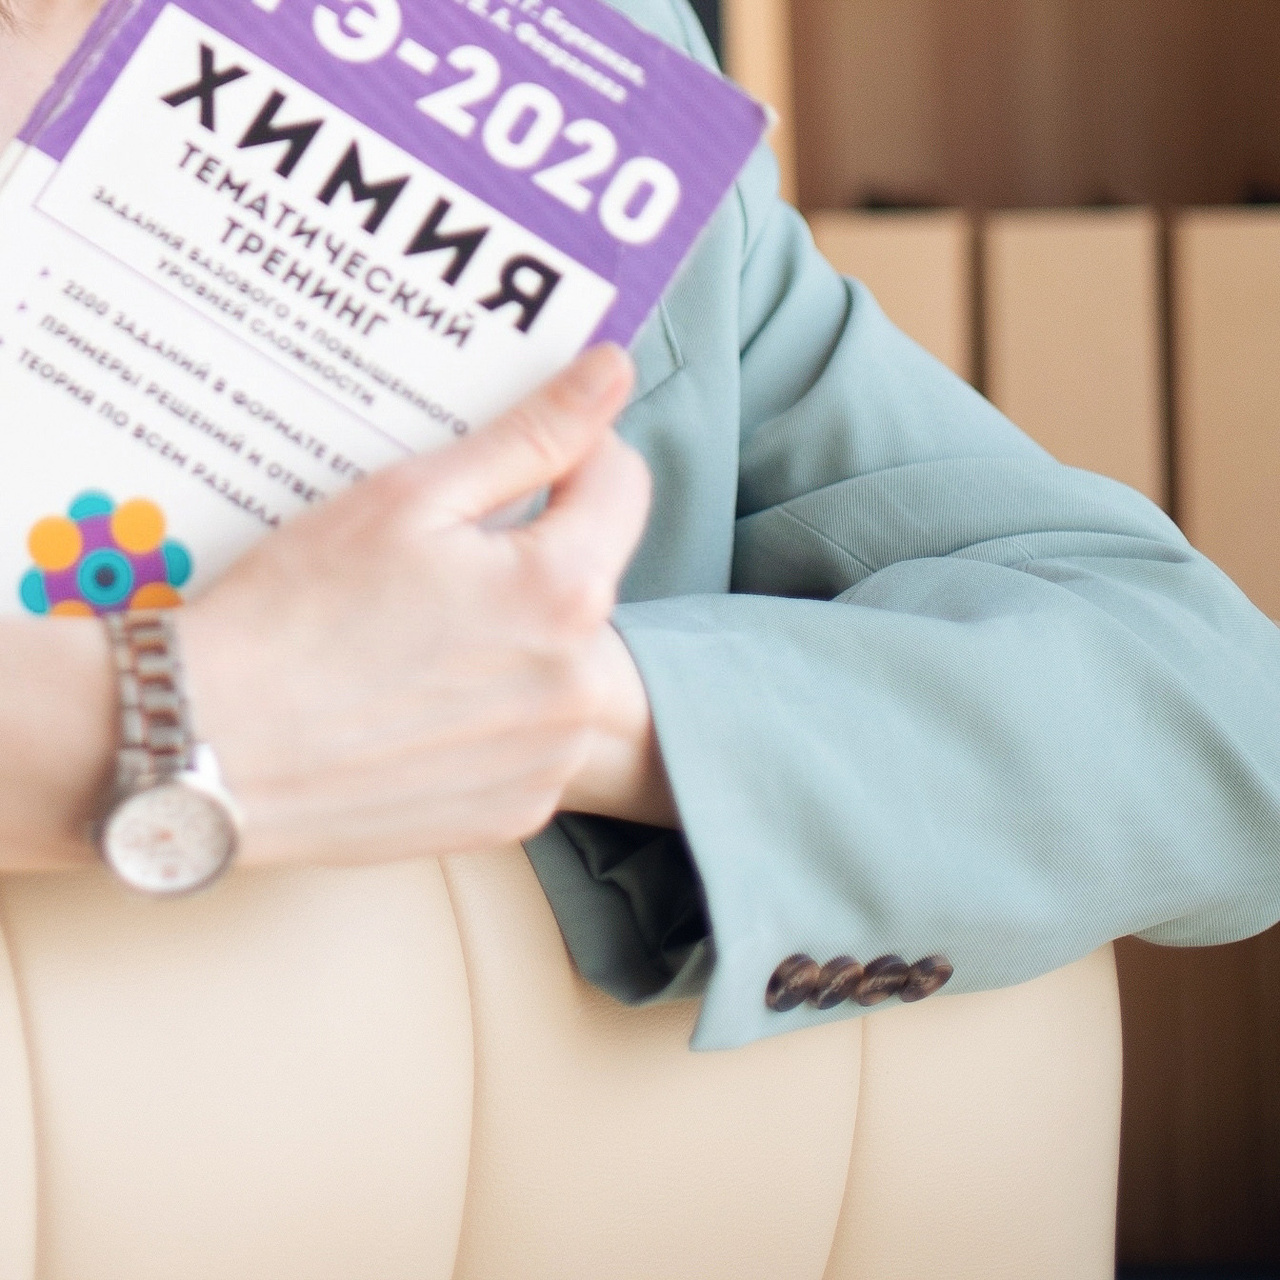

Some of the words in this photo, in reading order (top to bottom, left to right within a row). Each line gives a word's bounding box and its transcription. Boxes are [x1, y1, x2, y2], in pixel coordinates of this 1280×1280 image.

[160, 42, 562, 334] ХИМИЯ
[177, 140, 472, 348] ТЕМАТИЧЕСКИЙ
[91, 185, 185, 252] ЗАДАНИЯ
[186, 245, 291, 320] БАЗОВОГО
[310, 326, 471, 441] ПОВЫШЕННОГО
[155, 256, 248, 323] УРОВНЕЙ
[248, 317, 376, 408] СЛОЖНОСТИ
[219, 216, 388, 336] ТРЕНИНГ
[18, 347, 96, 407] ТЕОРИЯ
[95, 399, 130, 430] ПО
[130, 422, 188, 468] ВСЕМ
[38, 313, 142, 387] ПРИМЕРЫ
[142, 380, 245, 455] РЕШЕНИЙ
[60, 278, 110, 318] 2200
[111, 310, 210, 383] ЗАДАНИЙ
[229, 389, 328, 461] ФОРМАТЕ
